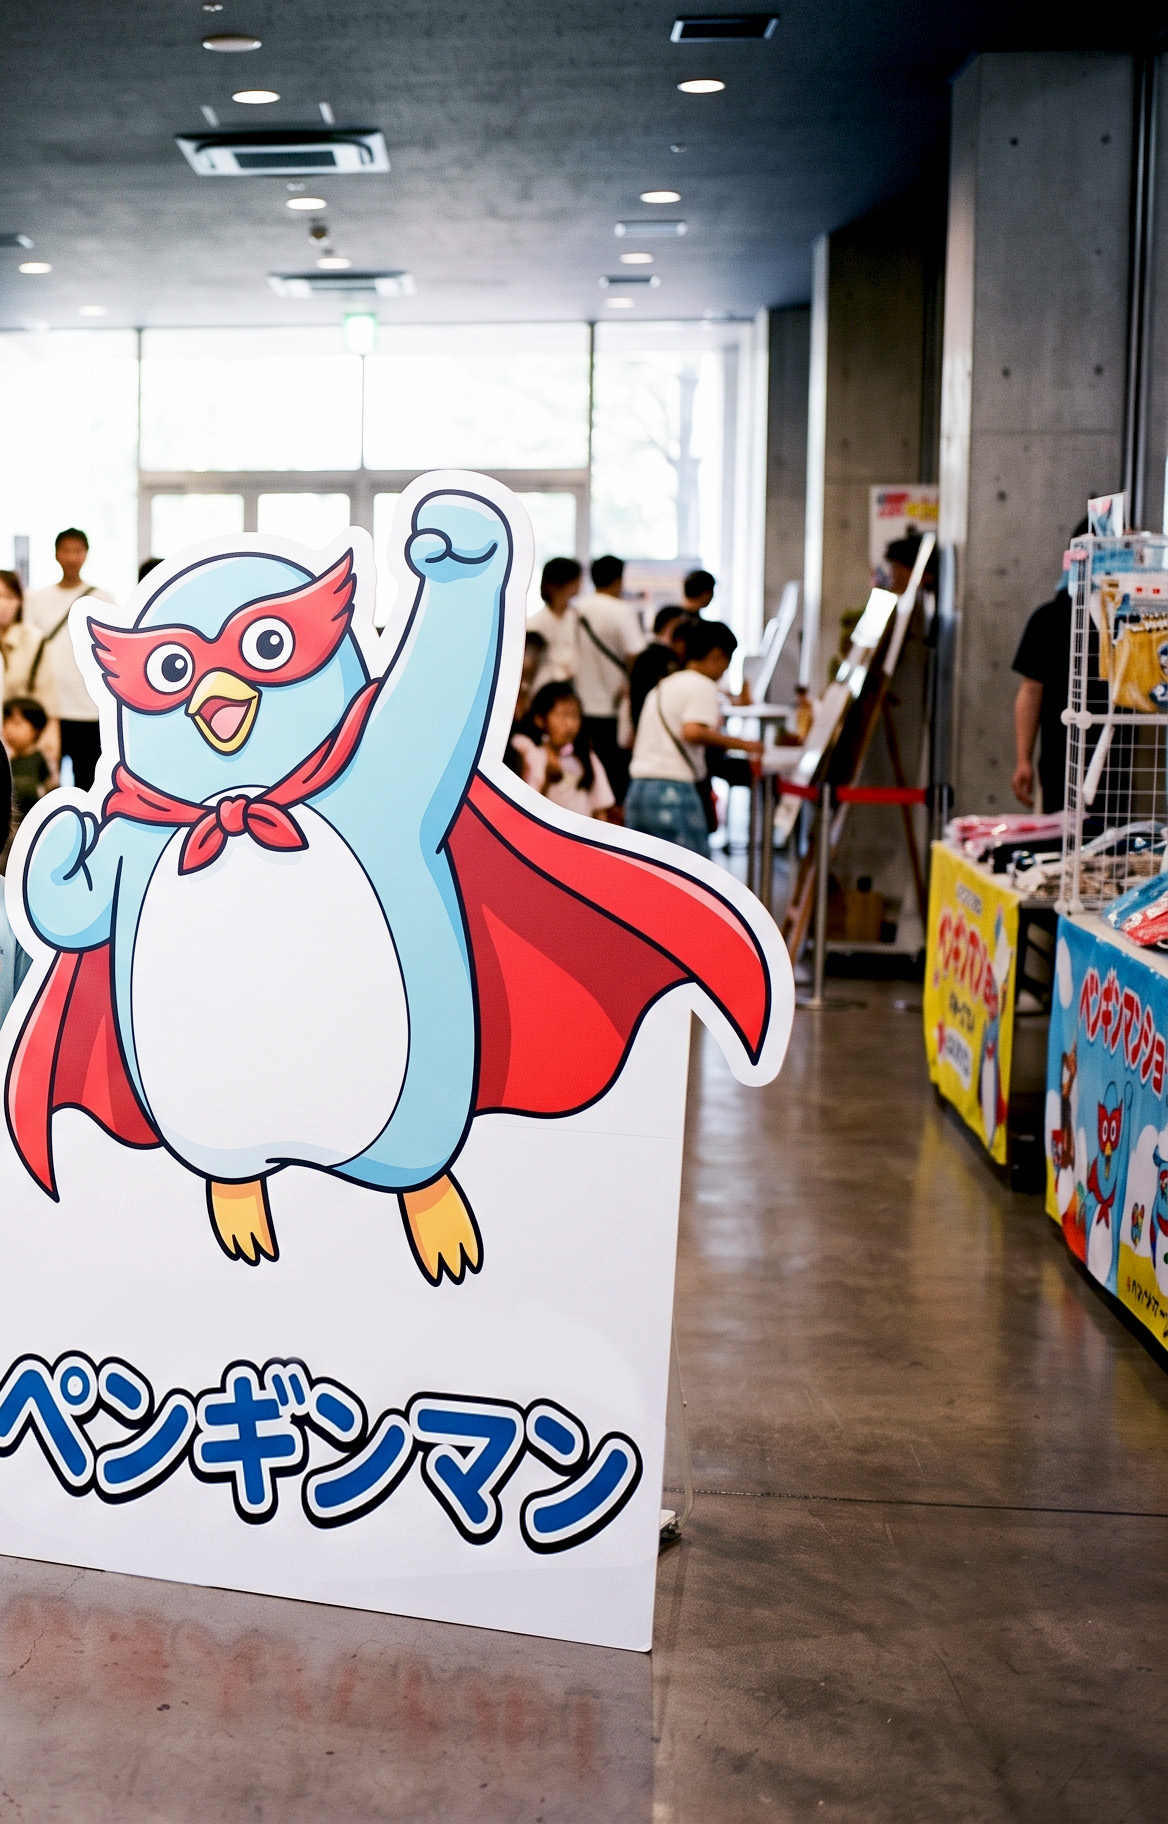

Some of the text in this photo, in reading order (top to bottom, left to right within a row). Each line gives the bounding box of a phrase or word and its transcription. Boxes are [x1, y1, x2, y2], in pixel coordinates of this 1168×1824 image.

[1078, 966, 1168, 1100] ペンギンマンショ
